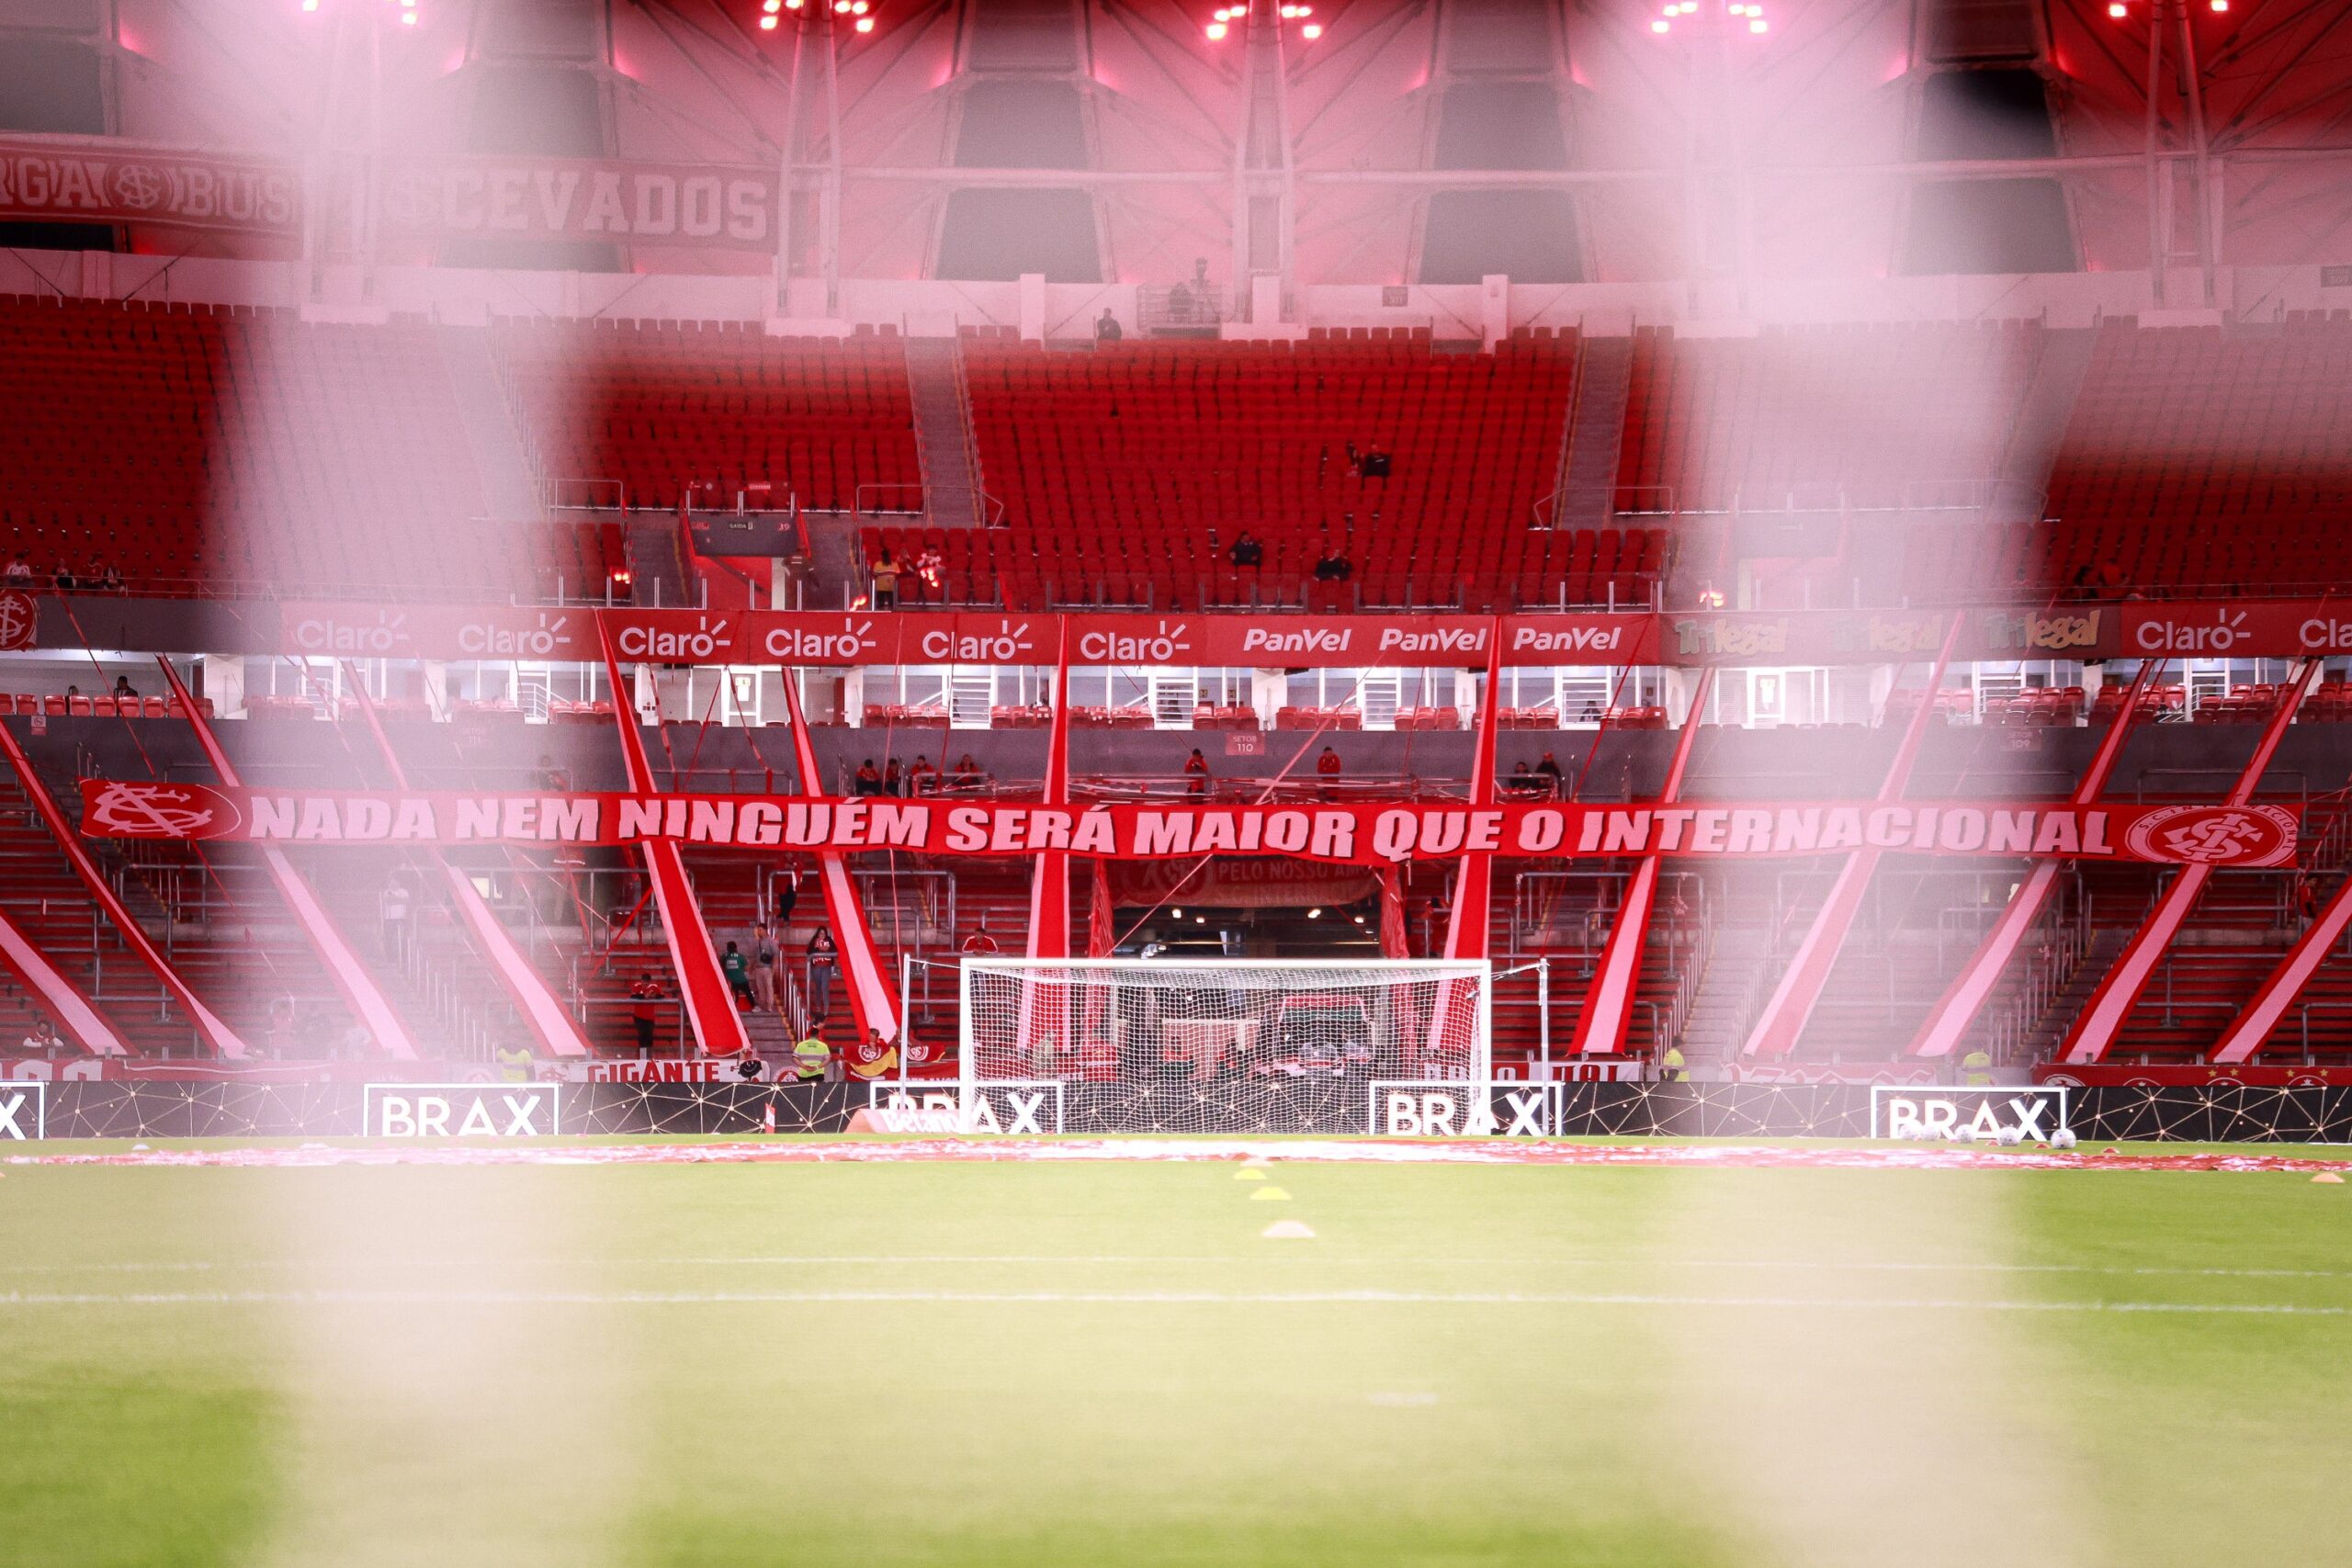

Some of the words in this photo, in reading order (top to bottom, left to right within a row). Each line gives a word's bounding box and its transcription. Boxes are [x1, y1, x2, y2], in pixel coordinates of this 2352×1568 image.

[443, 169, 766, 242] CEVADOS
[296, 610, 393, 652] Claro
[458, 614, 553, 654] Claro
[619, 615, 713, 657] Claro
[765, 617, 860, 658] Claro
[922, 620, 1018, 660] Claro
[1080, 621, 1174, 661] Claro
[1243, 628, 1351, 651] PanVel
[1379, 628, 1487, 651] PanVel
[1513, 626, 1622, 651] PanVel
[1833, 615, 1942, 654] legal
[2137, 608, 2233, 650] Claro
[1237, 743, 1254, 751] 110
[250, 796, 437, 840] NADA
[455, 798, 599, 841] NEM
[618, 795, 930, 846] NINGUÉM
[944, 805, 1116, 852] SERÁ
[1133, 809, 1355, 856] MAIOR
[1373, 809, 1501, 862] QUE
[1518, 810, 1561, 852] O
[1575, 807, 2114, 853] INTERNACIONAL
[587, 1062, 719, 1082] GIGANTE
[381, 1095, 541, 1136] BRAX
[1387, 1092, 1542, 1135] BRAX
[1889, 1099, 2049, 1142] BRAX
